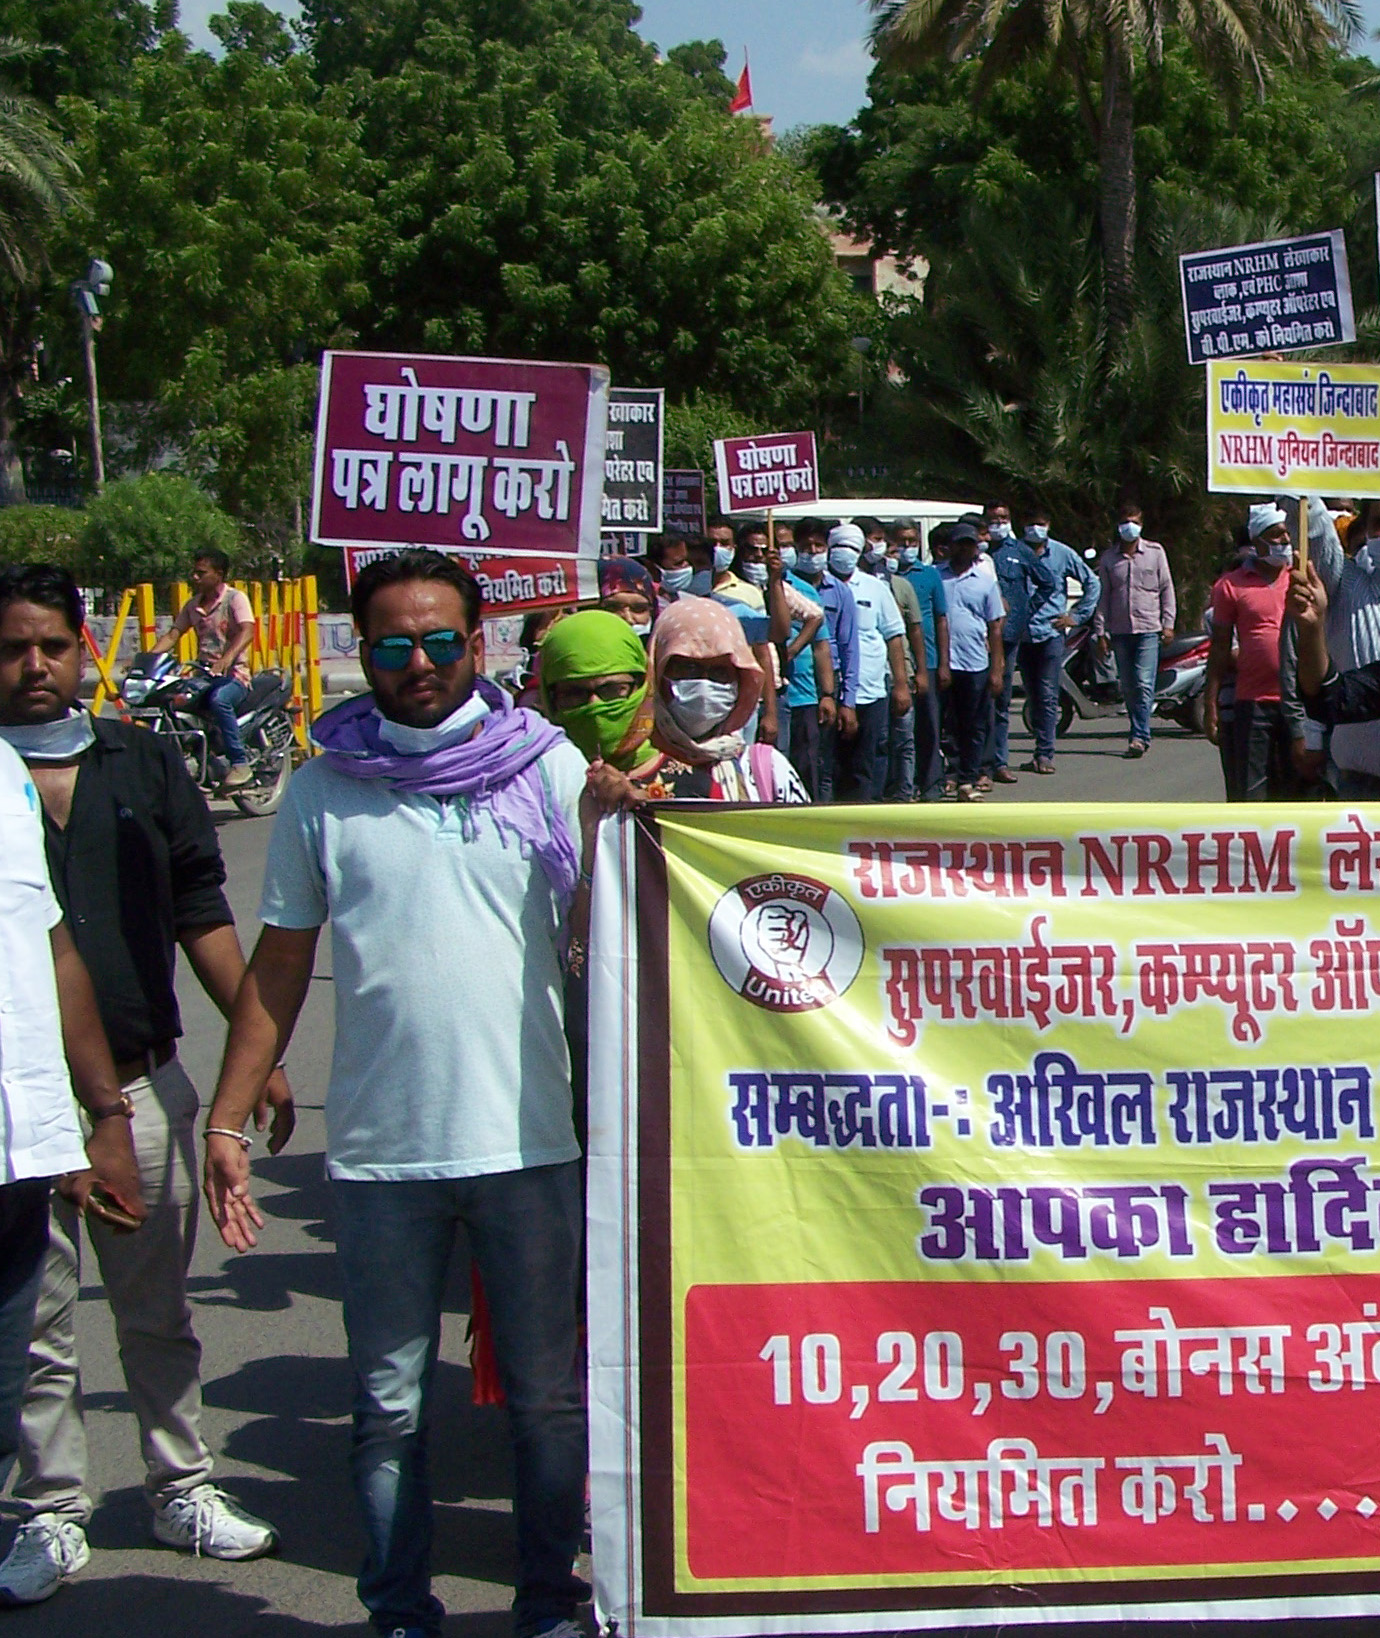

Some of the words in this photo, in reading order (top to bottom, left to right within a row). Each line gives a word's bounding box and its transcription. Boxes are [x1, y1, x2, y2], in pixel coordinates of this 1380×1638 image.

[1233, 253, 1280, 276] NRHM
[1256, 275, 1282, 294] PHC
[365, 368, 536, 447] घोषणा
[608, 403, 655, 422] खाकार
[1220, 370, 1269, 427] एकीकृत
[1272, 370, 1316, 416] महासंघ
[1318, 372, 1379, 418] जिन्दाबाद
[605, 454, 634, 482] परेटर
[736, 442, 797, 470] घोषणा
[1220, 434, 1273, 465] NRHM
[1277, 432, 1320, 476] युनियन
[1322, 432, 1380, 468] जिन्दाबाद
[332, 450, 393, 510] पत्र
[399, 452, 489, 540] लागू
[493, 440, 576, 520] करो
[730, 474, 753, 498] पत्र
[754, 470, 788, 502] लागू
[785, 460, 813, 492] करो
[623, 493, 648, 521] करो
[536, 563, 567, 597] करो
[849, 840, 1067, 898] राजस्थान
[1078, 829, 1297, 897] NRHM
[745, 875, 824, 900] एकीकृत
[746, 976, 828, 1005] Unite
[986, 1052, 1157, 1148] अखिल
[1166, 1066, 1374, 1145] राजस्थान
[918, 1185, 1193, 1262] आपका
[856, 1440, 1104, 1533] नियमित
